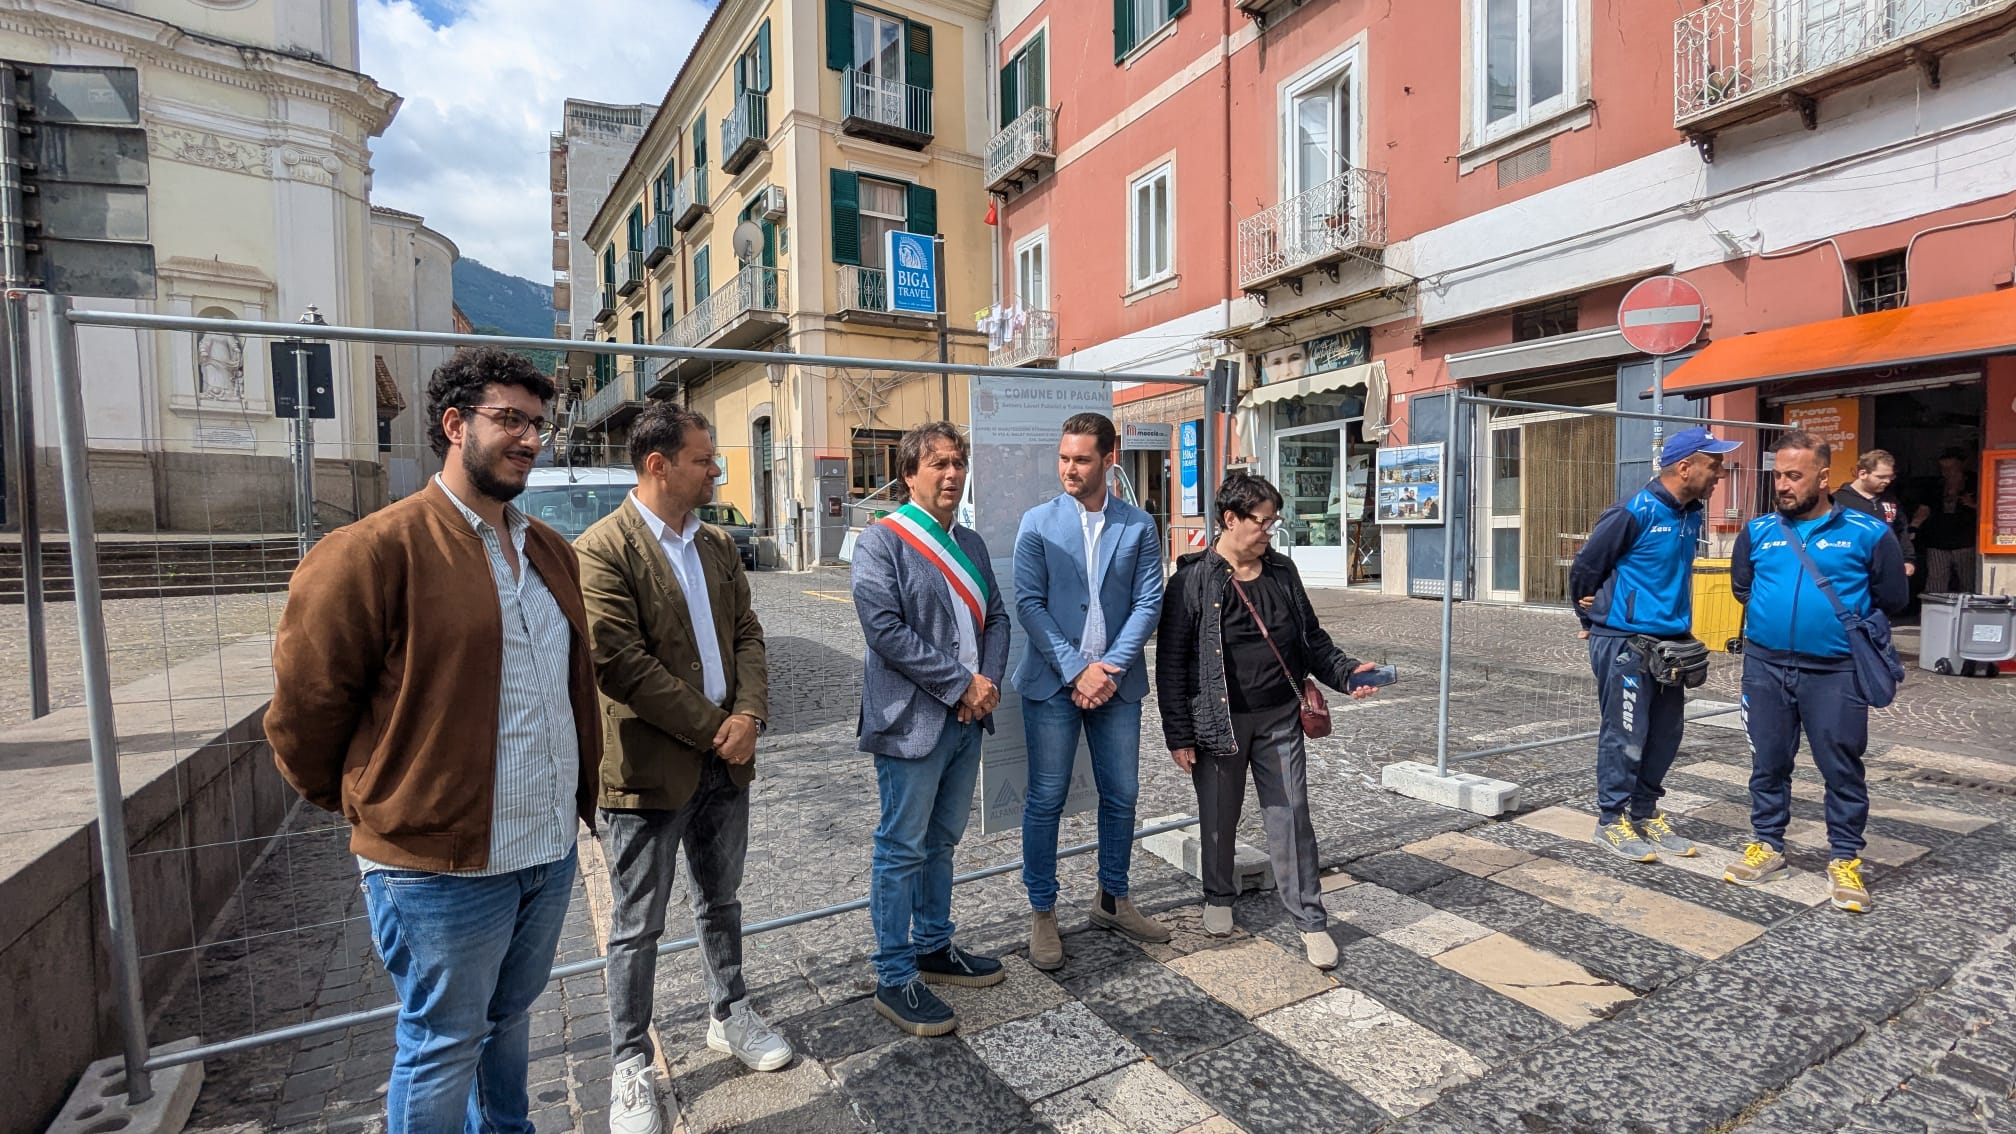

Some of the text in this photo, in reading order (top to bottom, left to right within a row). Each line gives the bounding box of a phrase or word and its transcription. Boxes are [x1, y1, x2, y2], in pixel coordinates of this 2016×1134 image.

[897, 270, 930, 289] BIGA
[897, 286, 932, 299] TRAVEL
[1005, 388, 1110, 402] COMUNE DI PAGANI
[1789, 407, 1838, 418] Trova
[1650, 525, 1672, 533] Zeus
[1622, 688, 1637, 732] Zeus
